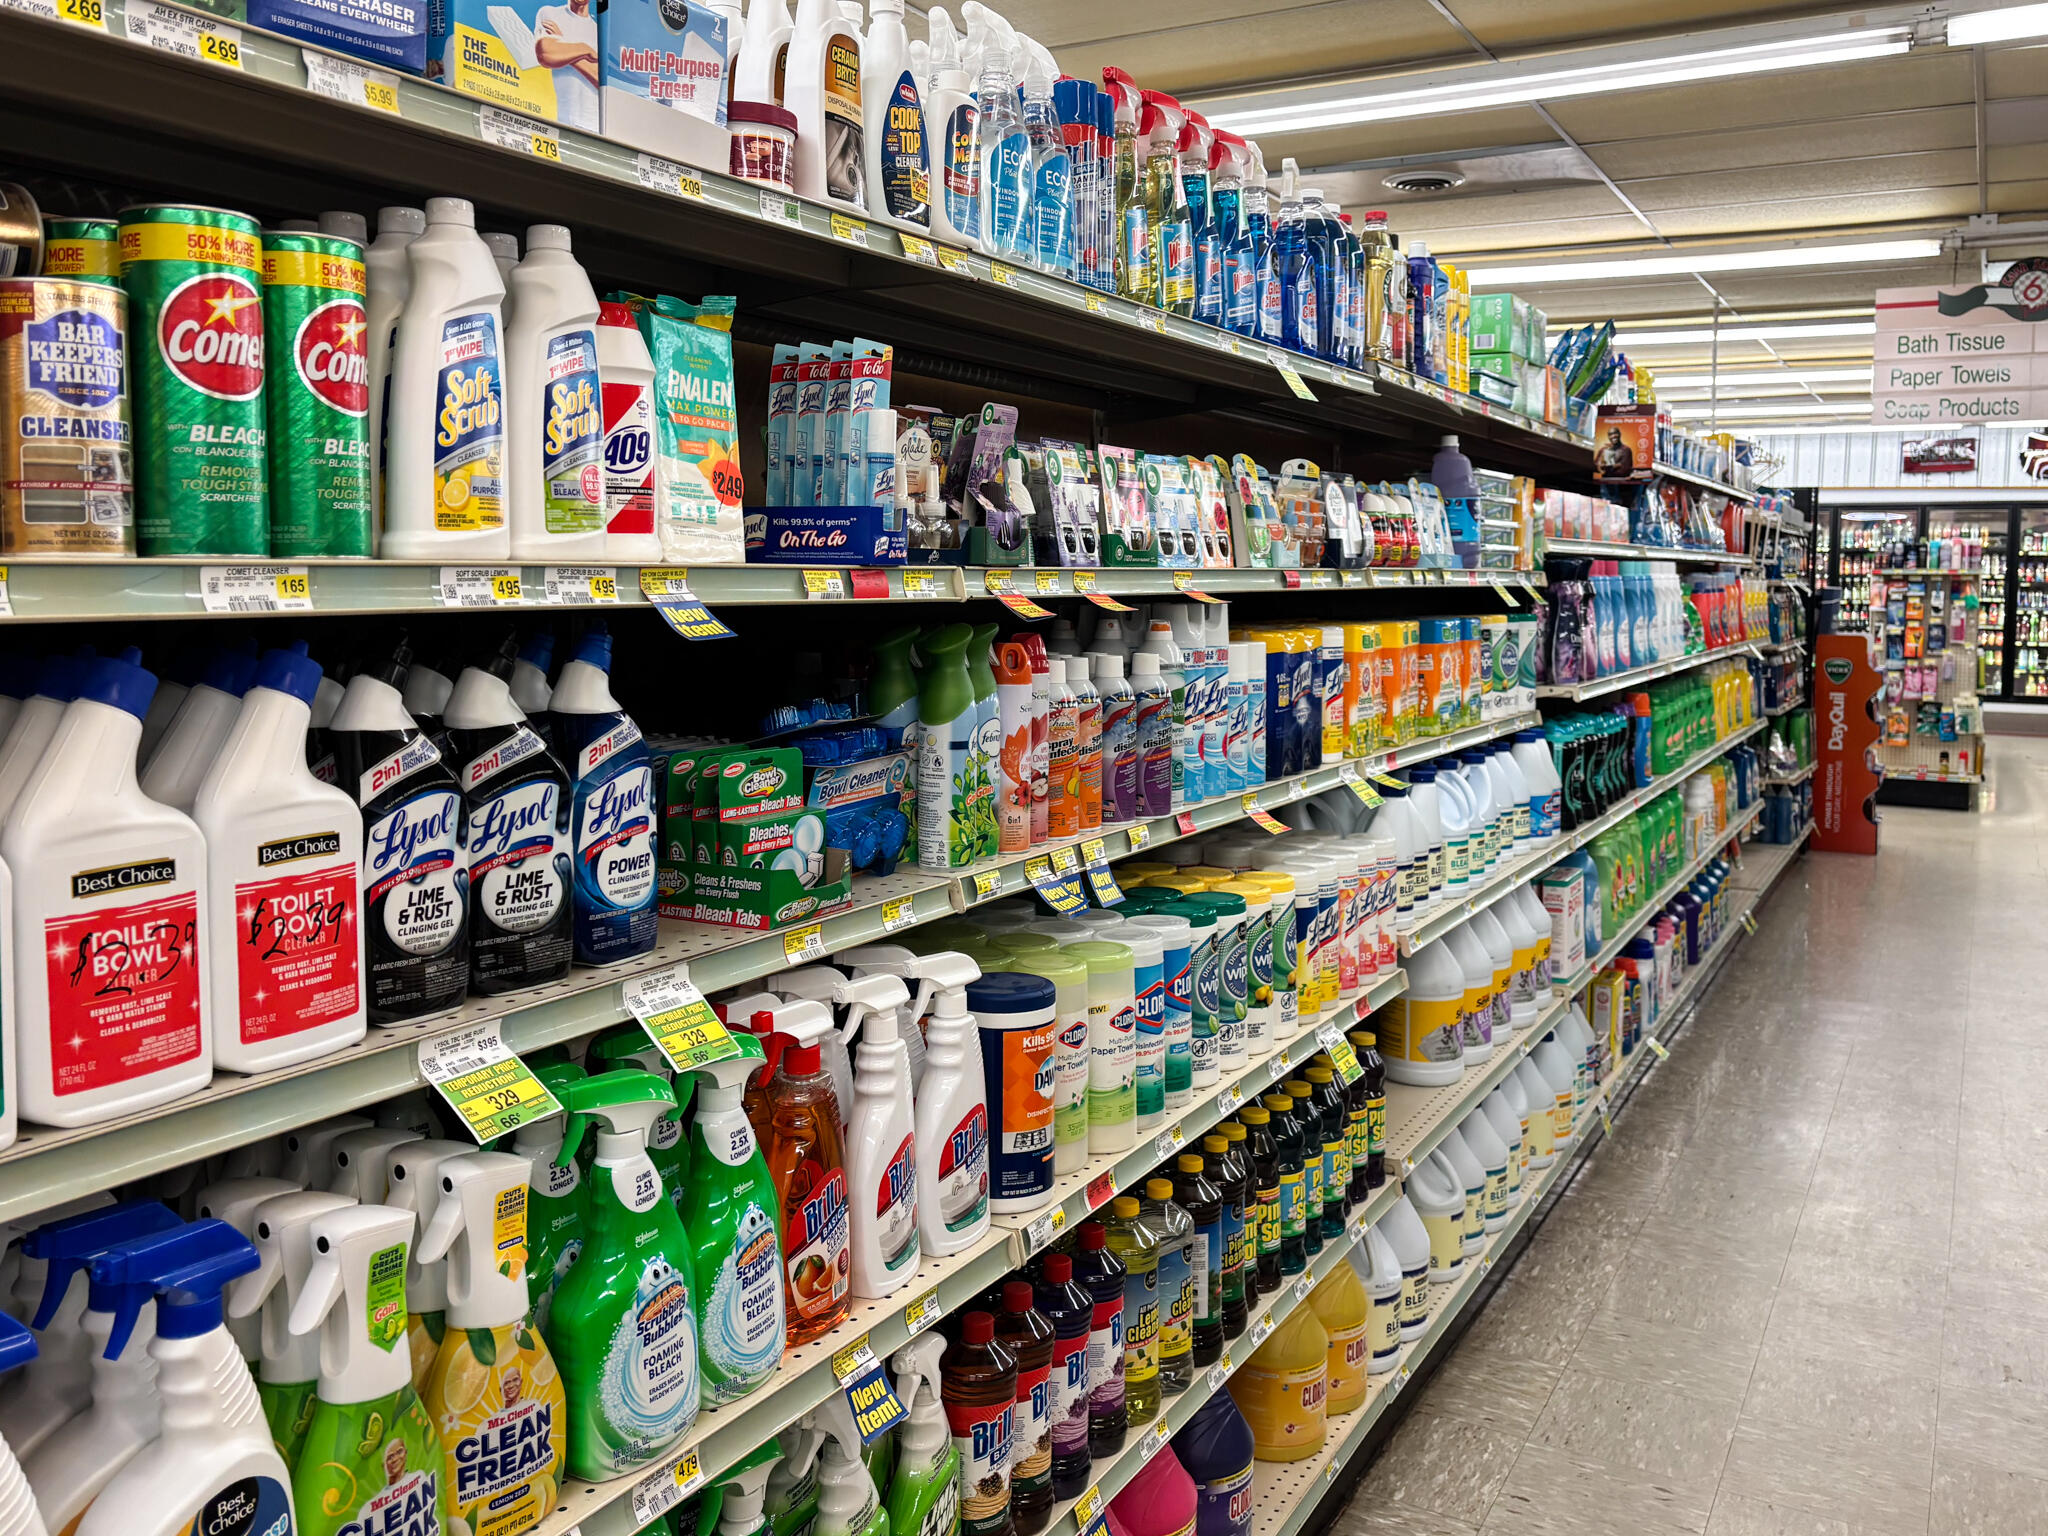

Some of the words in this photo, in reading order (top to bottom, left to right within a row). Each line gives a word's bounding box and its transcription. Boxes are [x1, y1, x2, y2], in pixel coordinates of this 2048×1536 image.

[155, 7, 165, 16] AH
[167, 9, 177, 19] EX
[180, 13, 194, 23] STR
[196, 21, 216, 31] CARP
[715, 18, 720, 33] 2
[463, 35, 487, 54] THE
[464, 50, 519, 79] ORIGINAL
[621, 48, 719, 78] Multi-Purpose
[832, 46, 858, 68] CERAMA
[836, 63, 856, 85] BRYTE
[364, 84, 392, 105] $5.99
[650, 77, 695, 99] Eraser
[502, 114, 513, 124] CLN
[515, 118, 531, 129] MAGIC
[532, 124, 549, 134] ERASE
[900, 131, 921, 154] TOP
[896, 155, 922, 168] CLEANER
[187, 234, 220, 250] 50%
[225, 237, 255, 257] MORE
[2024, 275, 2043, 302] 6
[58, 321, 106, 345] BAR
[457, 334, 466, 344] from
[1898, 335, 1939, 354] Bath
[1946, 333, 2005, 351] Tissue
[30, 341, 123, 369] KEEPERS
[683, 355, 712, 365] CLEANING
[40, 361, 120, 385] FRIEND
[862, 362, 873, 375] To
[873, 361, 884, 374] Go
[1890, 368, 1943, 389] Paper
[1951, 366, 2011, 384] Towels
[445, 367, 492, 408] Soft
[854, 382, 876, 406] Lysol
[551, 380, 593, 419] Soft
[666, 399, 691, 412] MAX
[695, 403, 735, 418] POWER
[1884, 400, 1930, 421] Soap
[1939, 398, 2019, 417] Products
[20, 416, 130, 443] CLEANSER
[438, 394, 500, 446] Scrub
[546, 404, 599, 455] Scrub
[692, 418, 704, 426] GO
[707, 419, 725, 429] PACK
[190, 425, 265, 446] BLEACH
[457, 448, 485, 463] CLEANSER
[605, 431, 650, 466] 409
[901, 437, 927, 460] glade
[554, 484, 581, 496] BLEACH
[773, 518, 789, 526] Kills
[791, 518, 814, 526] 99.9%
[816, 518, 824, 526] of
[780, 530, 800, 548] On
[801, 530, 825, 546] The
[827, 531, 847, 547] Go
[253, 567, 289, 575] CLEANSER
[662, 606, 710, 623] New
[675, 621, 730, 638] Item!
[1828, 692, 1848, 750] DayQuil
[744, 778, 779, 794] Cleaner
[753, 769, 776, 783] Bowl
[723, 805, 759, 818] LONG-LASTING
[760, 798, 785, 811] Bleach
[786, 795, 801, 807] Tabs
[373, 795, 453, 870] Lysol
[749, 824, 789, 842] Bleaches
[262, 847, 292, 863] Best
[294, 838, 339, 856] Choice
[747, 843, 760, 852] with
[761, 840, 776, 850] Every
[777, 837, 791, 847] Flush
[608, 853, 650, 875] POWER
[78, 875, 116, 894] Best
[118, 865, 175, 886] Choice
[505, 870, 544, 890] LIME
[694, 873, 718, 887] Cleans
[720, 877, 726, 887] &
[727, 878, 762, 891] Freshens
[1093, 868, 1114, 889] New
[269, 887, 335, 916] TOILET
[408, 886, 444, 907] LIME
[706, 889, 721, 898] Every
[723, 890, 739, 899] Flush
[1096, 883, 1121, 901] Item!
[495, 903, 537, 917] CLINGING
[540, 901, 554, 909] GEL
[694, 904, 733, 922] Bleach
[736, 909, 762, 927] Tabs
[91, 918, 169, 953] TOILET
[398, 923, 438, 937] CLINGING
[440, 919, 454, 929] GEL
[93, 943, 169, 976] BOWL
[1346, 967, 1355, 975] 35
[648, 1009, 687, 1026] TEMPORARY
[688, 1002, 707, 1013] PRICE
[661, 1014, 705, 1033] REDUCTION!
[1023, 1033, 1045, 1049] Kills
[1091, 1046, 1116, 1056] Paper
[444, 1068, 495, 1092] TEMPORARY
[494, 1059, 519, 1075] PRICE
[460, 1073, 518, 1098] REDUCTION!
[730, 1127, 747, 1140] CLINGS
[730, 1134, 749, 1152] 2.5X
[952, 1113, 983, 1168] Brillo
[730, 1145, 751, 1161] LONGER
[635, 1170, 652, 1183] CLINGS
[888, 1141, 915, 1204] Brillo
[504, 1188, 521, 1198] CUTS
[636, 1180, 654, 1196] 2.5X
[498, 1193, 525, 1206] GREASE
[635, 1191, 657, 1207] LONGER
[804, 1175, 843, 1243] Brillo
[373, 1254, 403, 1270] GREASE
[379, 1249, 399, 1260] CUTS
[374, 1303, 398, 1322] Gain
[637, 1292, 686, 1336] Scrubbing
[761, 1315, 771, 1326] MOLD
[643, 1310, 684, 1348] Bubbles
[643, 1336, 684, 1368] FOAMING
[649, 1380, 666, 1396] ERASES
[668, 1373, 679, 1386] MOLD
[850, 1377, 888, 1414] New
[856, 1396, 903, 1438] Item!
[455, 1403, 551, 1463] CLEAN
[458, 1428, 552, 1493] FREAK
[492, 1494, 513, 1508] LEMON
[514, 1487, 529, 1499] ZEST
